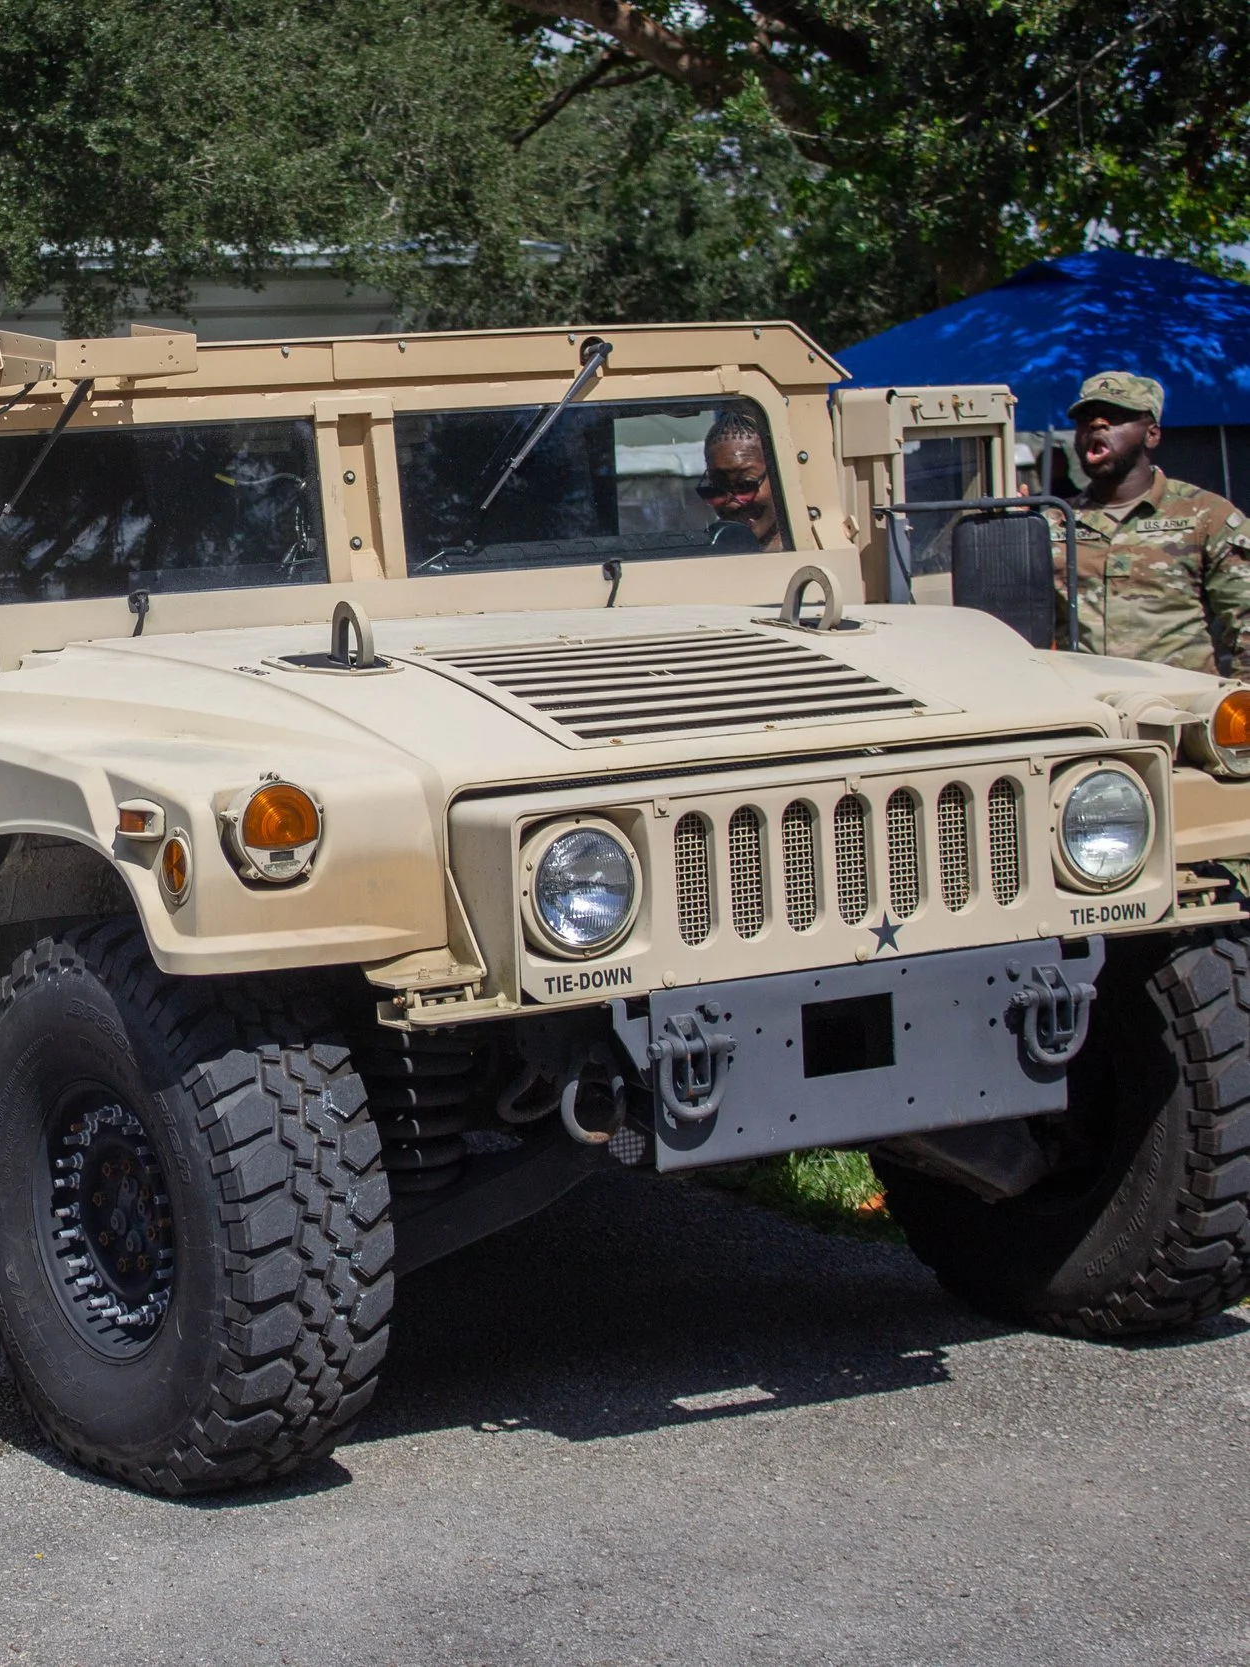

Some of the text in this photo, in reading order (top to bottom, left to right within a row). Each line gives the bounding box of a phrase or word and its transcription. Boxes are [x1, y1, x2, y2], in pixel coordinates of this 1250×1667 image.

[1163, 519, 1189, 528] ARMY
[1070, 902, 1146, 926] TIE-DOWN
[544, 966, 632, 995] TIE-DOWN
